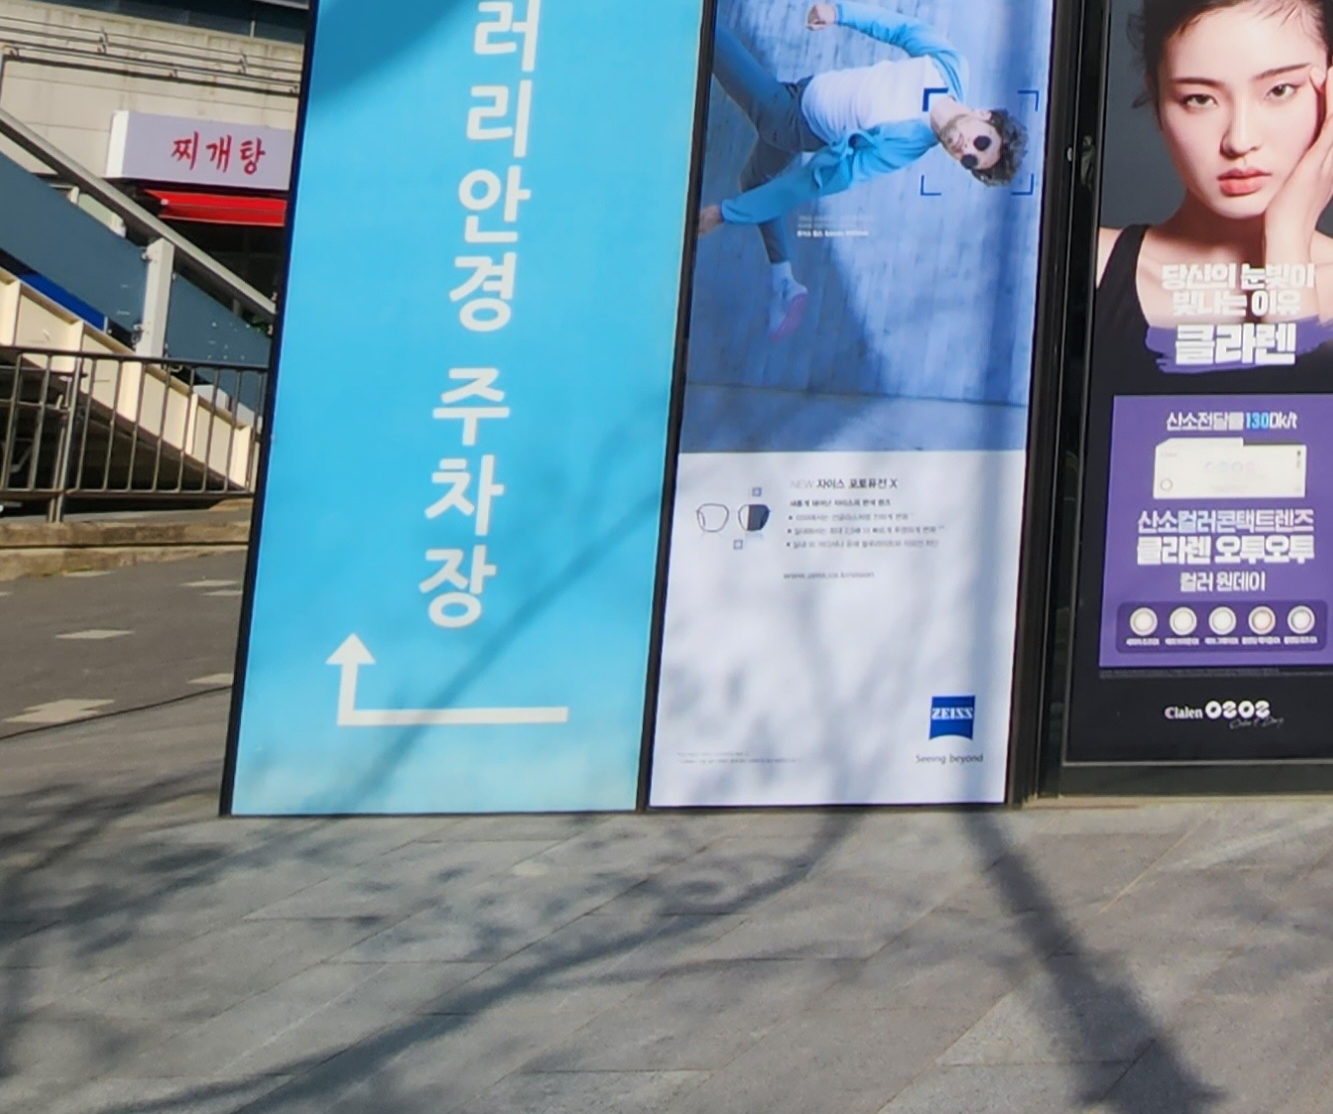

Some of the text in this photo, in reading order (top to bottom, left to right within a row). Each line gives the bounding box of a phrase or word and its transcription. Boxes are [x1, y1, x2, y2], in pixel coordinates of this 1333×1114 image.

[1162, 263, 1316, 290] 당신의 눈빛이
[1172, 290, 1301, 317] 빛나는 이유
[1175, 323, 1297, 365] 클라렌
[419, 367, 510, 628] 주차장
[1137, 535, 1315, 566] 클라렌 오투오투
[1180, 571, 1266, 592] 컬러 원데이
[931, 706, 975, 720] ZEISS
